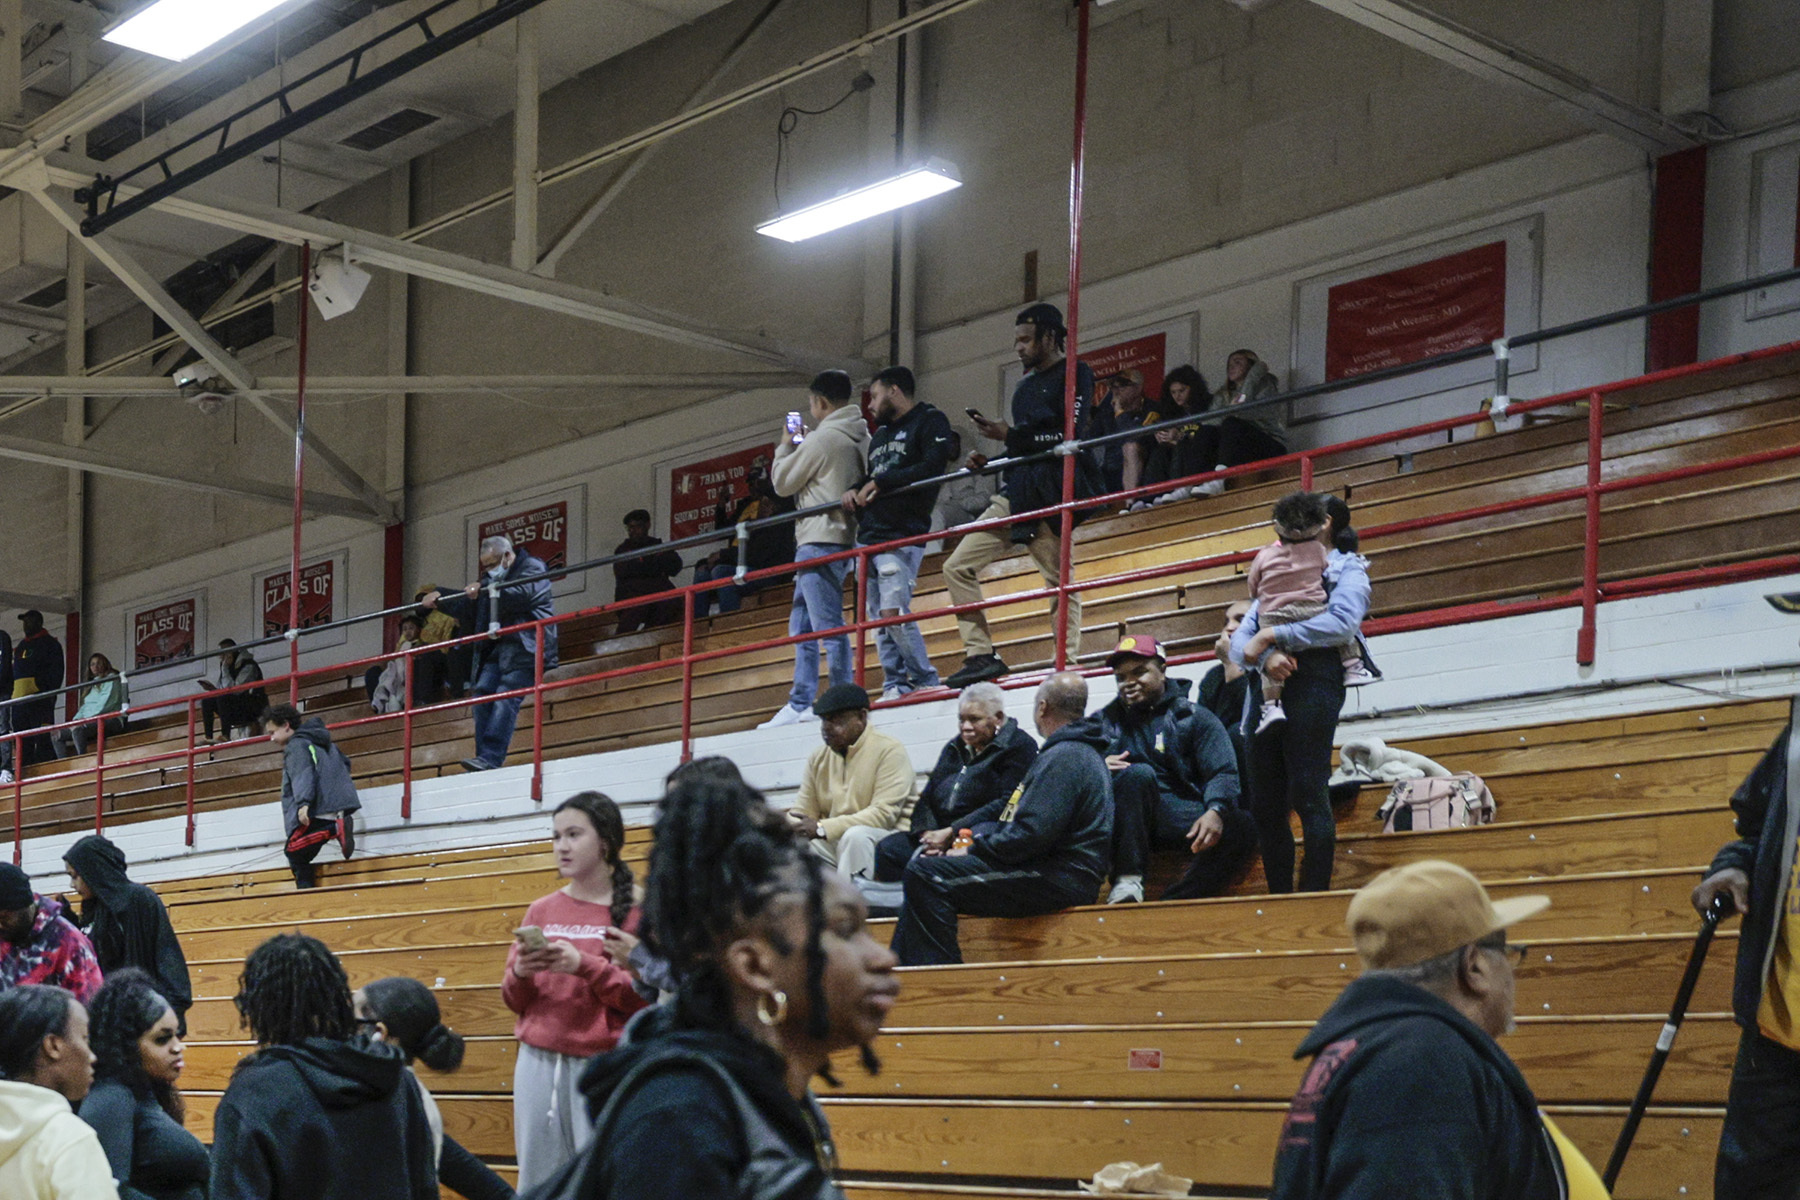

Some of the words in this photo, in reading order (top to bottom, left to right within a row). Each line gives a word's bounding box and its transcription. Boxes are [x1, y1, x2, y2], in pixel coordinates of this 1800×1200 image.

[1074, 396, 1082, 423] TOM
[1034, 433, 1063, 441] LFIGER
[700, 471, 726, 486] THANK
[728, 466, 744, 479] YOU
[706, 489, 716, 500] TO
[486, 523, 505, 535] MAKE
[506, 517, 526, 529] SOME
[674, 509, 699, 524] SOUND
[542, 517, 564, 542] OF
[266, 580, 308, 613] CLAS
[314, 574, 331, 596] OF
[137, 617, 174, 646] CLASS
[178, 612, 193, 632] OF
